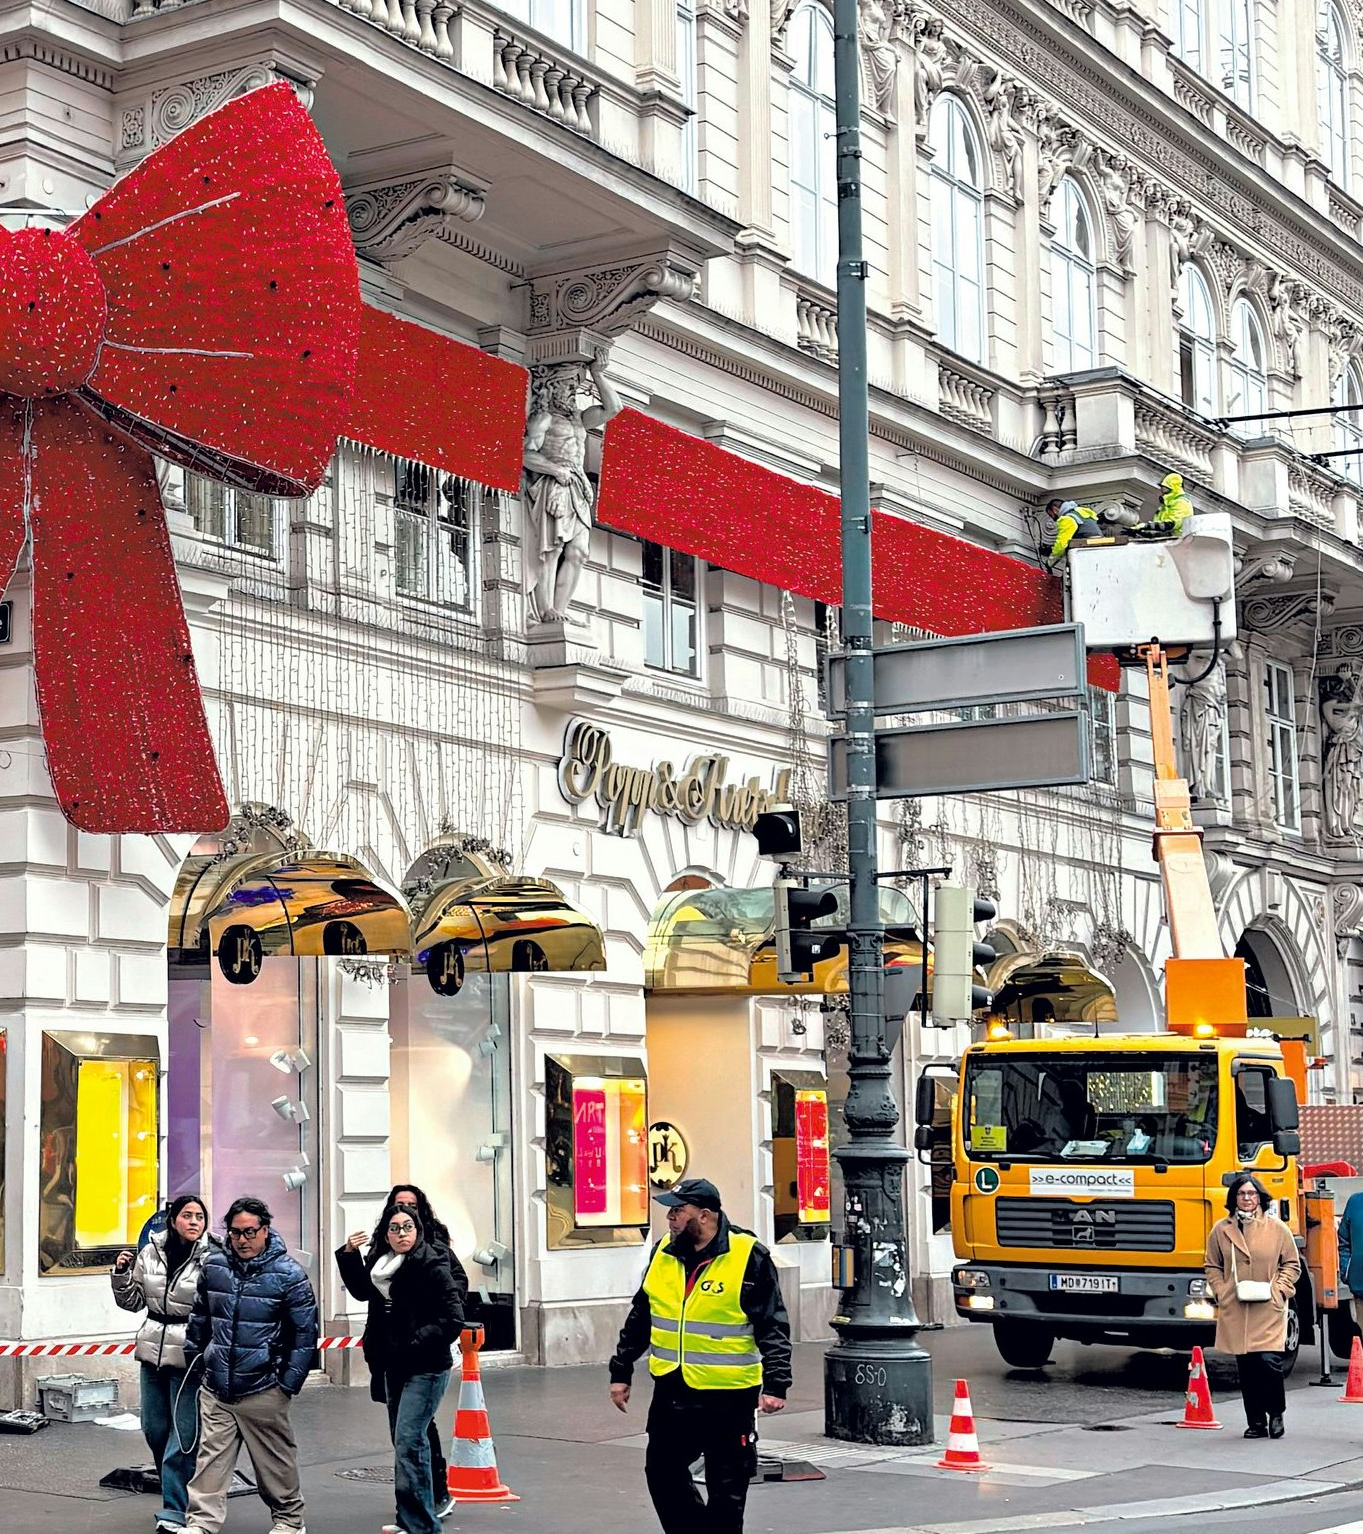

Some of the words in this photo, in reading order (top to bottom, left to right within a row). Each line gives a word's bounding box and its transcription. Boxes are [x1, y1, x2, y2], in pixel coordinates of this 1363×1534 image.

[565, 721, 655, 830] Popp
[656, 760, 684, 810] &
[574, 1101, 605, 1124] ART
[981, 1171, 993, 1189] L
